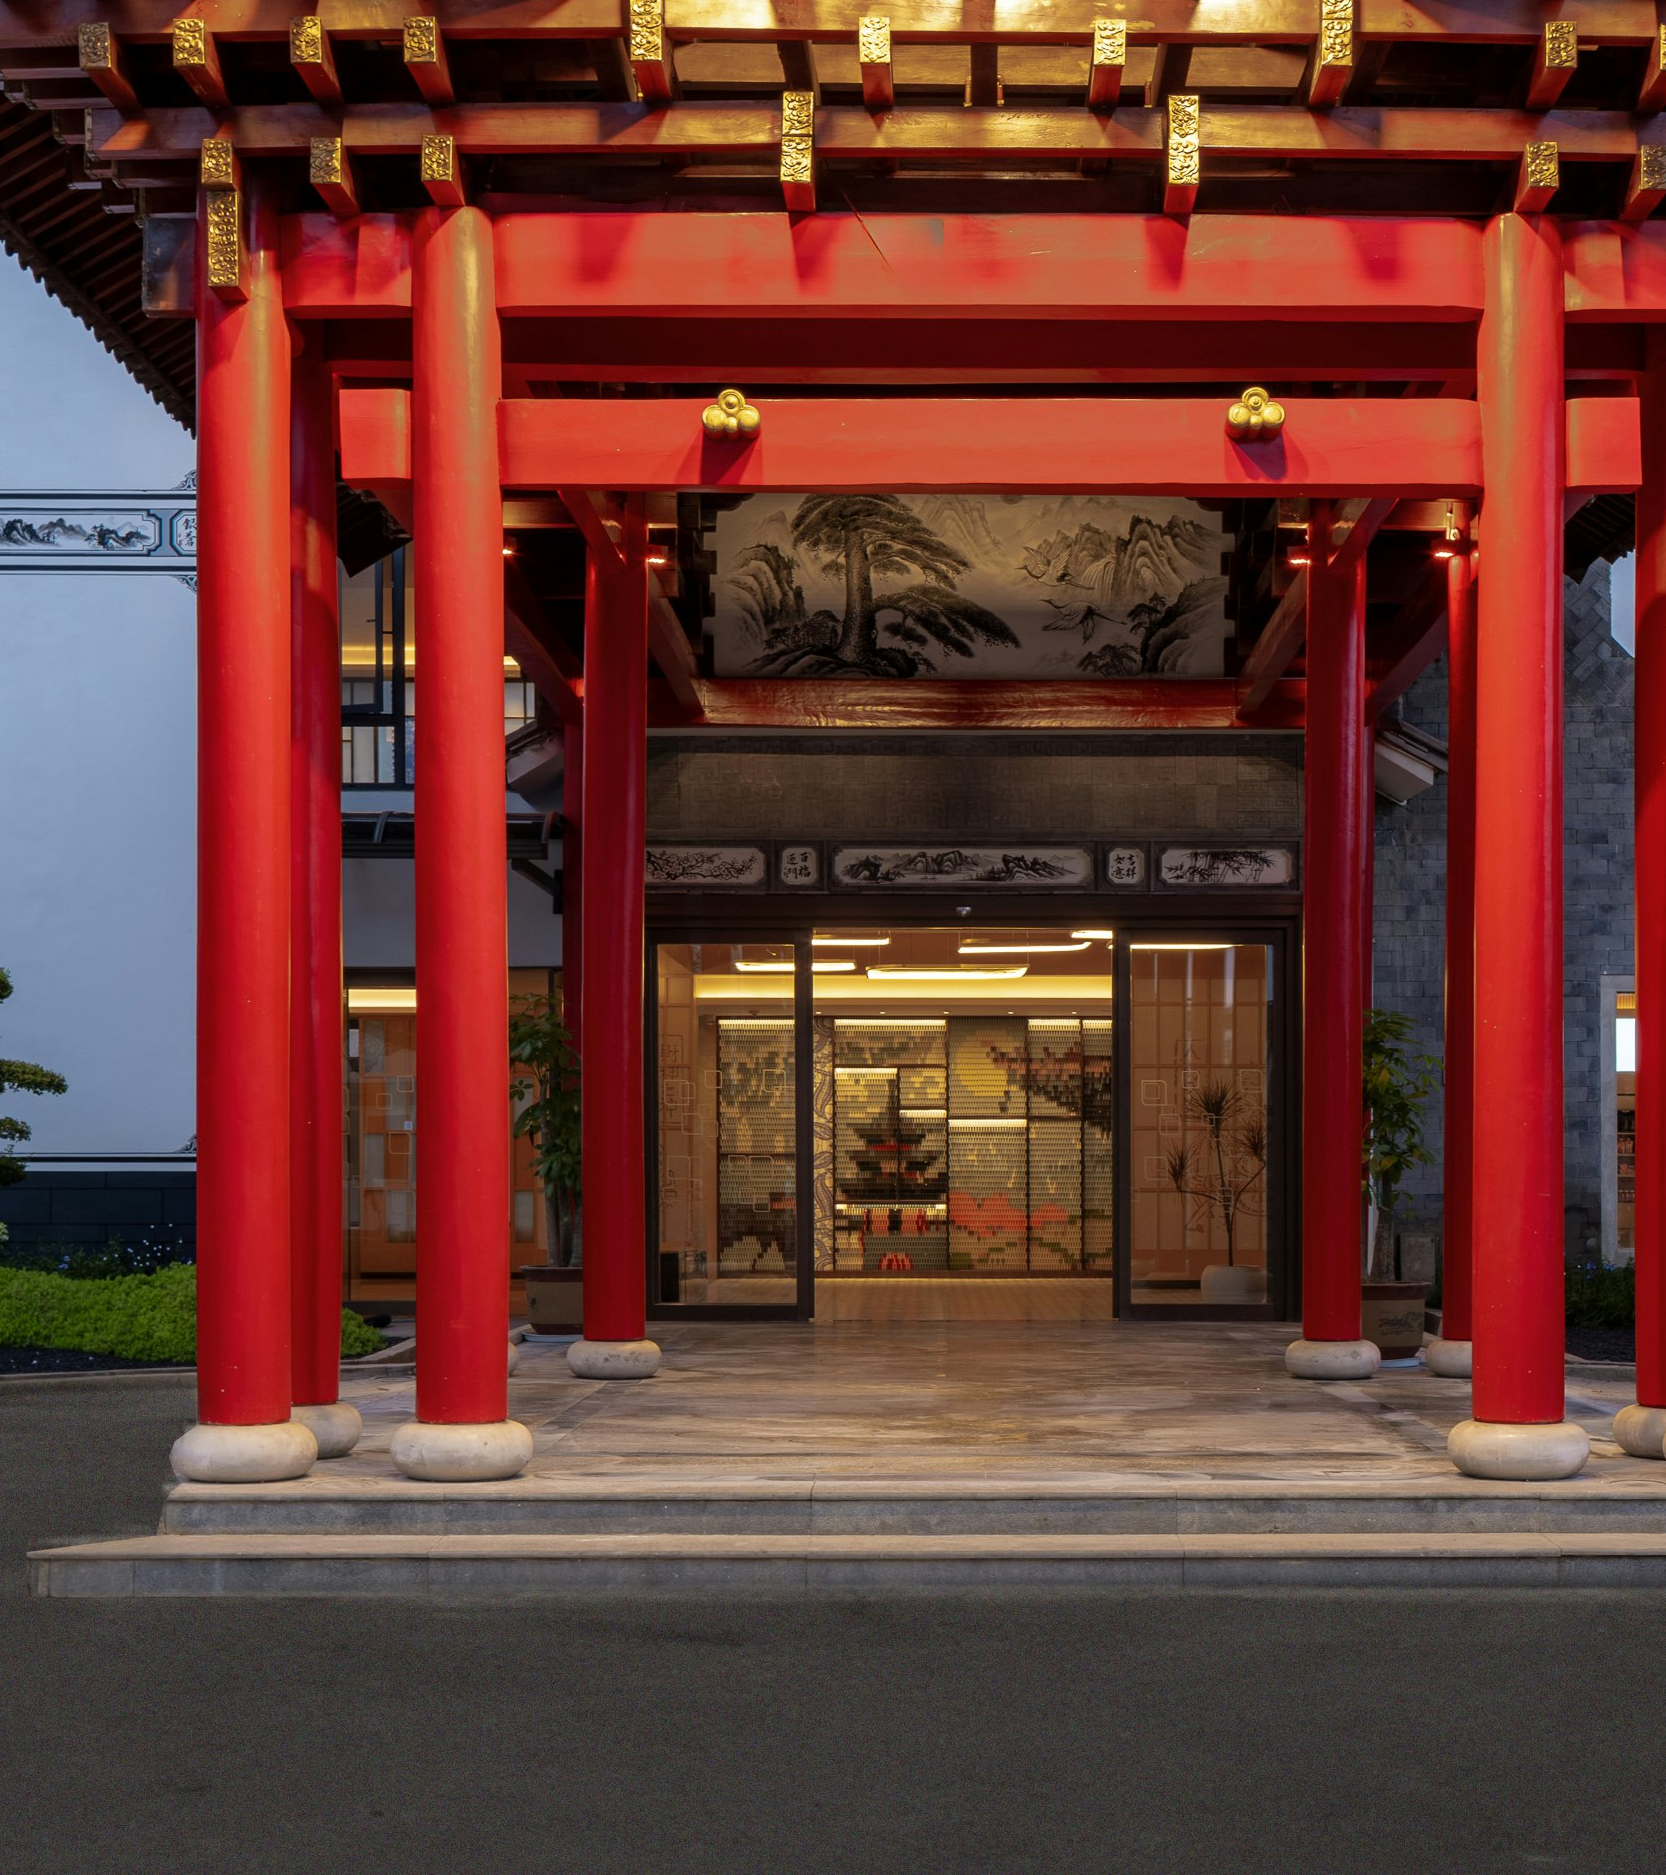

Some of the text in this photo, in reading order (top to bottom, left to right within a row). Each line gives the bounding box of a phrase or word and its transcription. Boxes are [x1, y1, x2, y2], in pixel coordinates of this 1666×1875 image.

[799, 851, 812, 878] 百福
[1112, 853, 1126, 880] 如意
[1125, 853, 1138, 879] 吉祥
